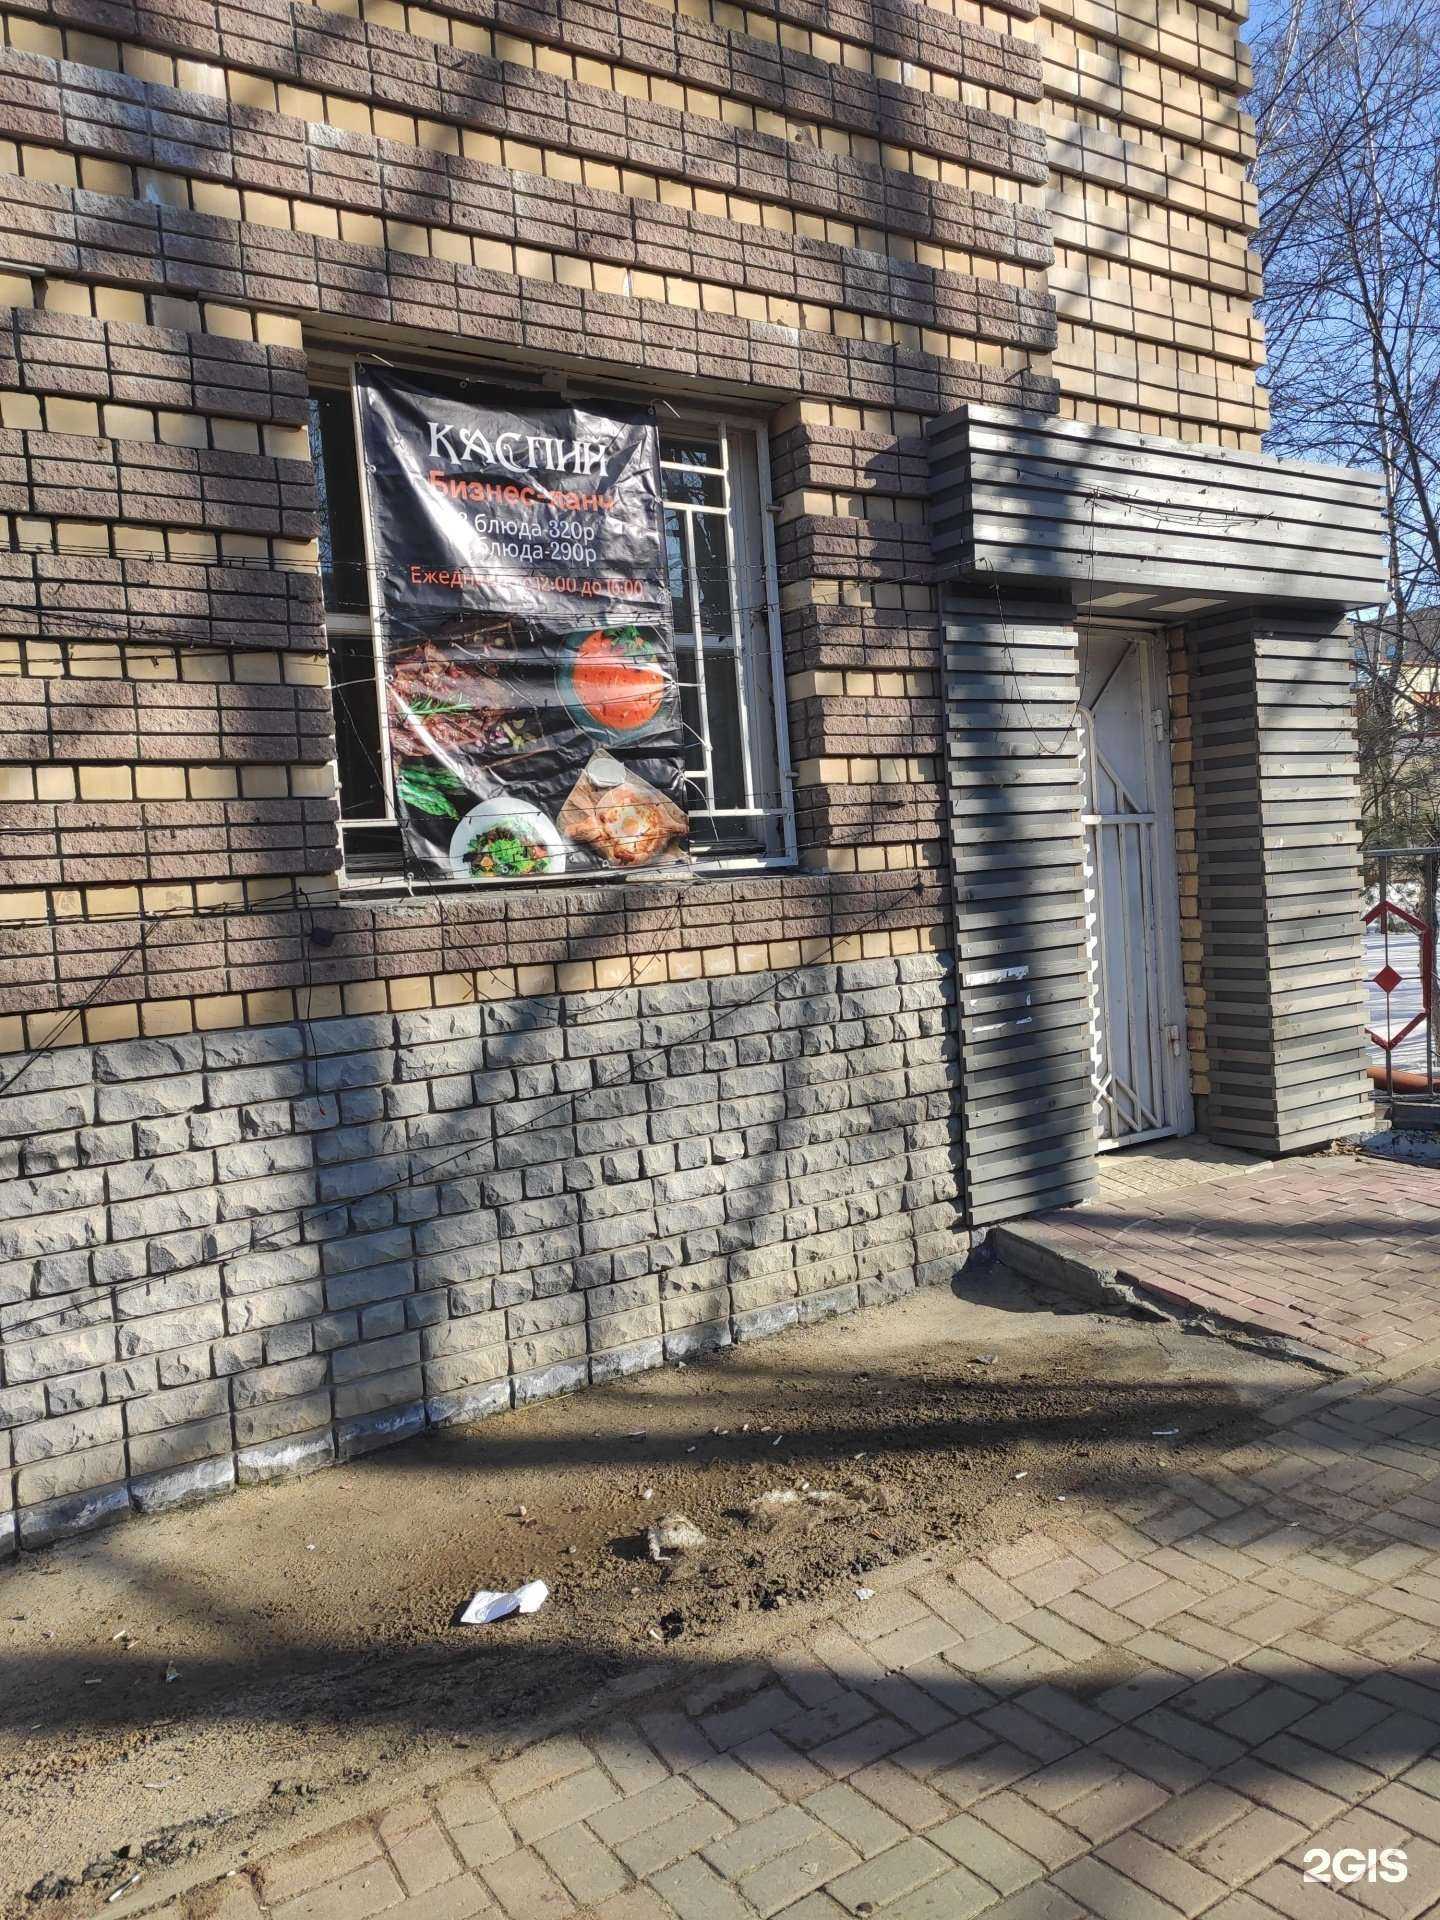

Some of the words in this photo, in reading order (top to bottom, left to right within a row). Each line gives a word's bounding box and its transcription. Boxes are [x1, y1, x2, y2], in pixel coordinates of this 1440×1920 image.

[427, 421, 608, 477] КАСПИЙ
[428, 470, 614, 513] Бизнес-ланч
[474, 513, 595, 546] блюда-320р
[535, 575, 577, 593] 12:00
[582, 579, 602, 598] до
